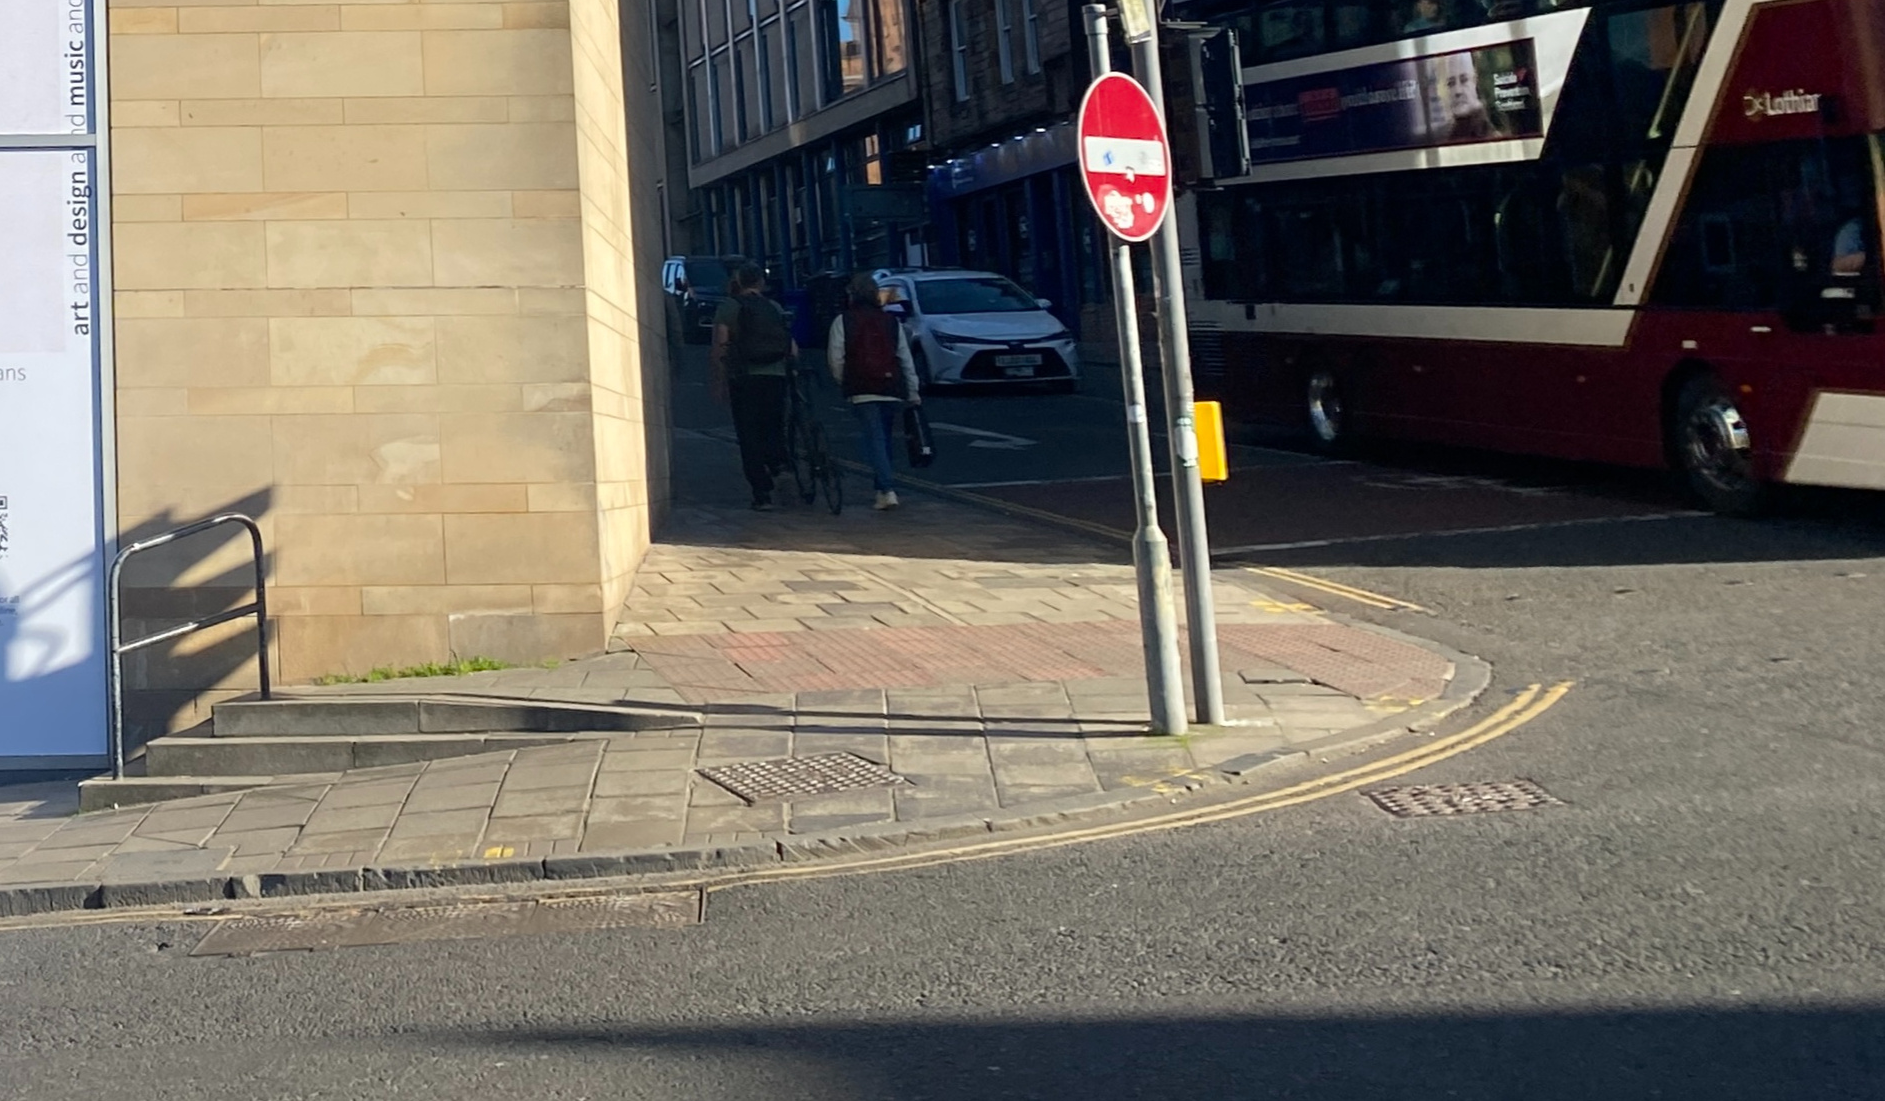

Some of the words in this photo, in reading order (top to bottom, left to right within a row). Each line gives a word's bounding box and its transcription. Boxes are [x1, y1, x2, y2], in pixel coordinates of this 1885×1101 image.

[64, 40, 85, 106] music
[67, 171, 92, 246] design
[67, 254, 89, 294] and
[70, 301, 90, 336] art
